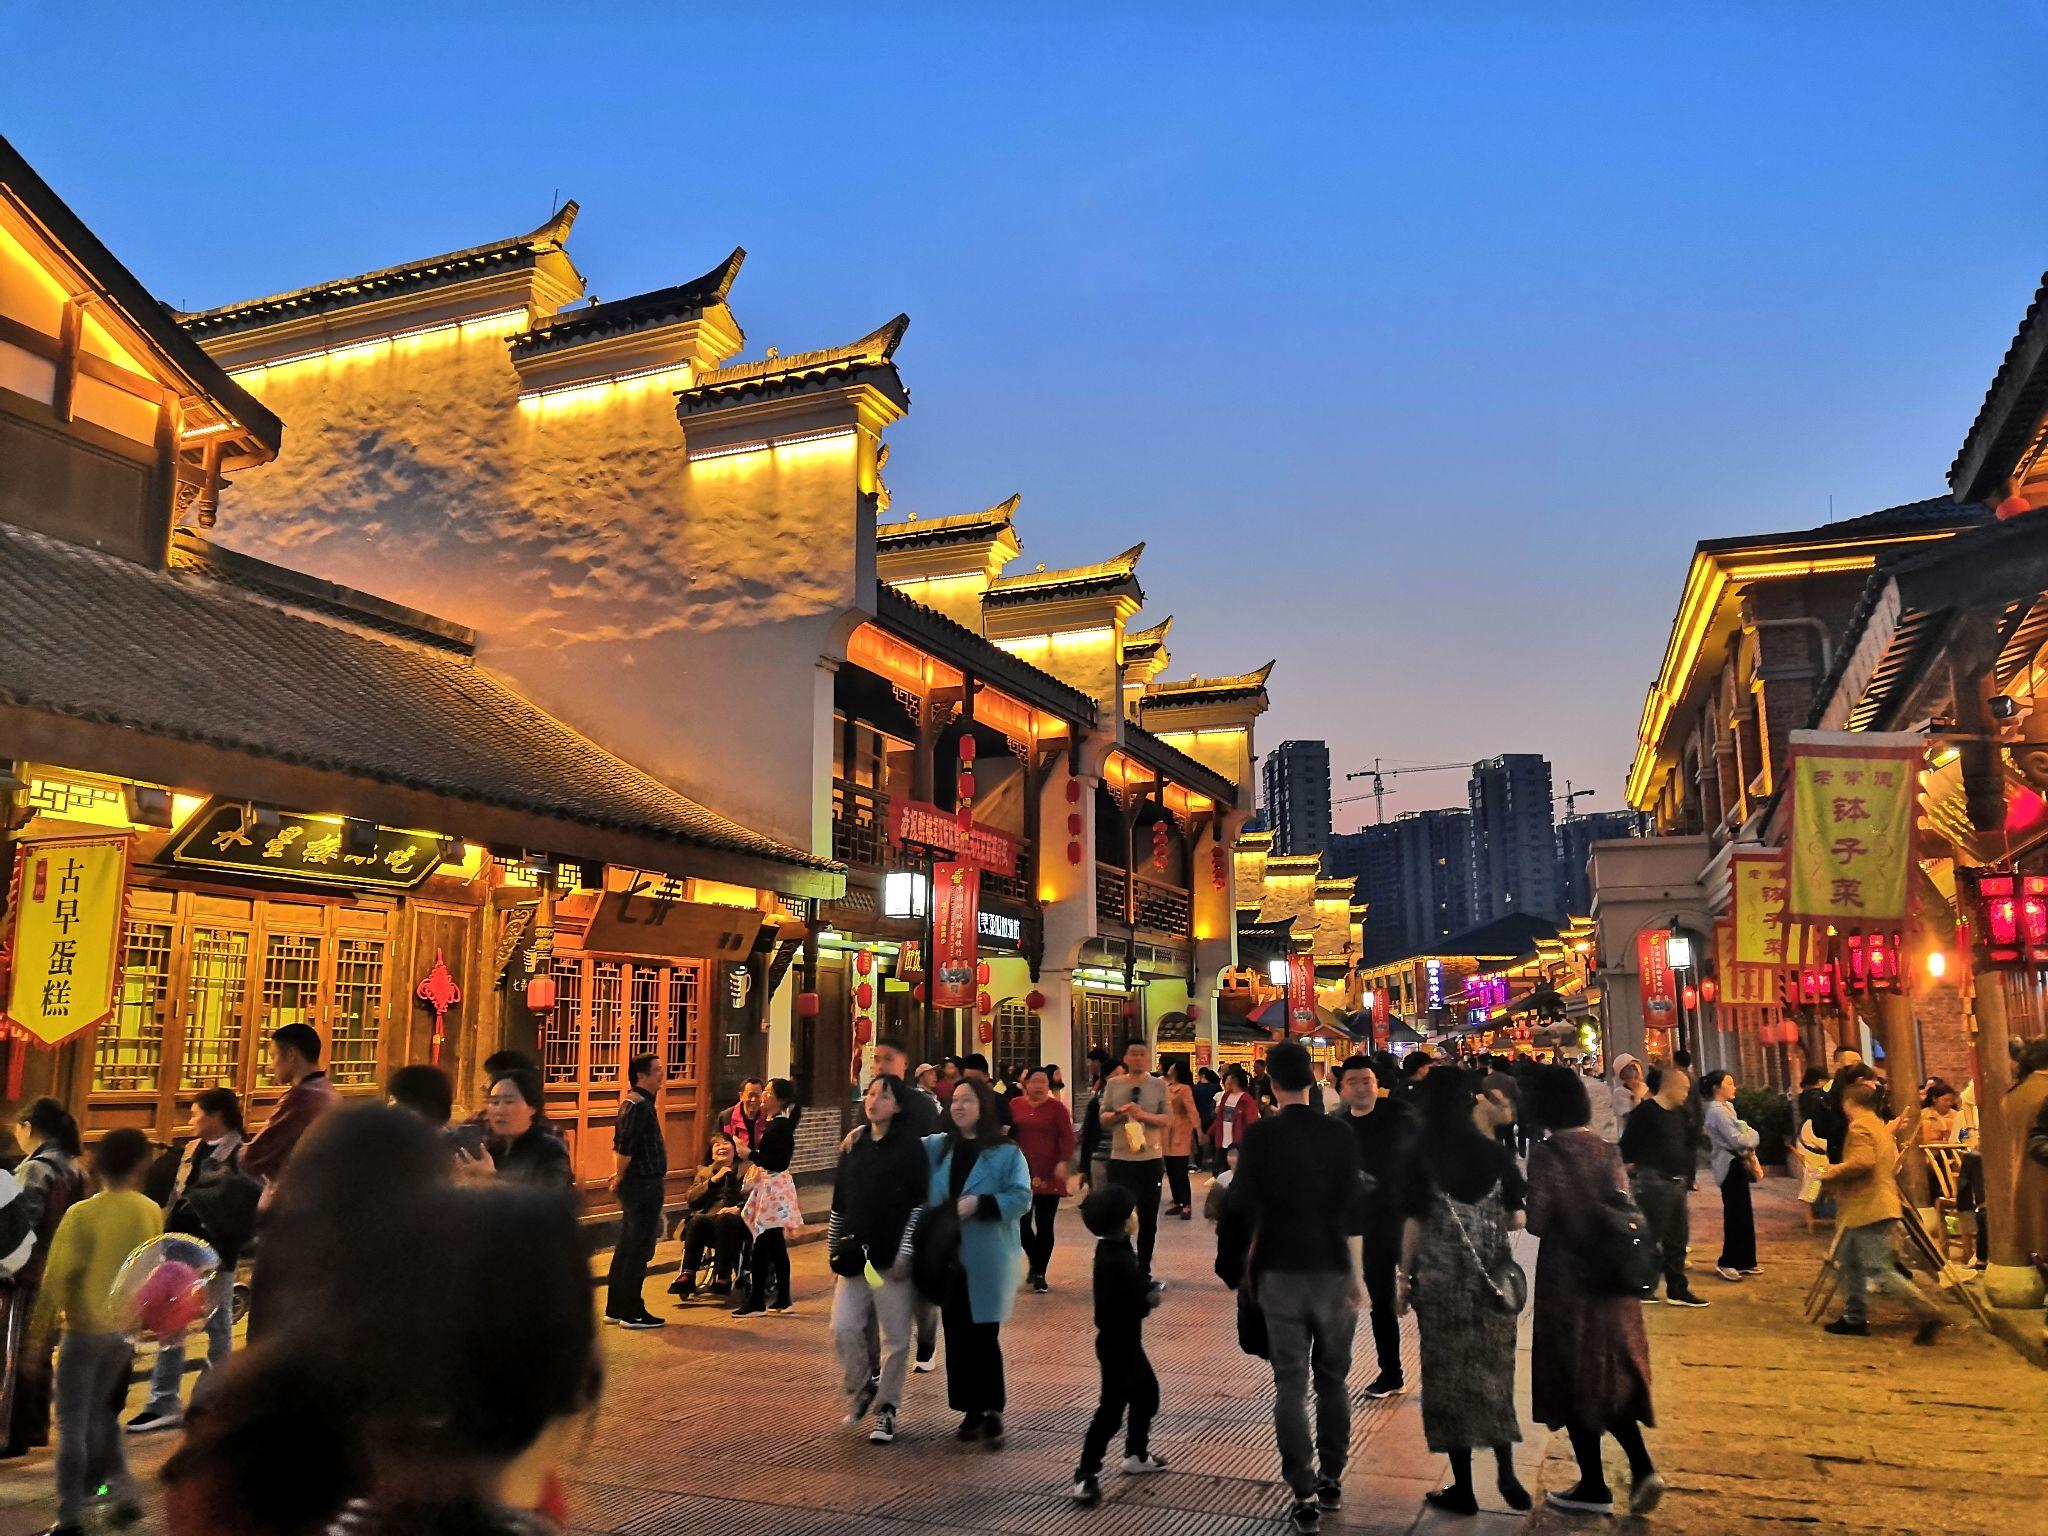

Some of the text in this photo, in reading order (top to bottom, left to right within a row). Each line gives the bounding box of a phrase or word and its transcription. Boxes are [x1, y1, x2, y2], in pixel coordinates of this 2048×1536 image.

[1830, 796, 1871, 908] 钵子菜
[41, 858, 84, 1017] 古早蛋糕
